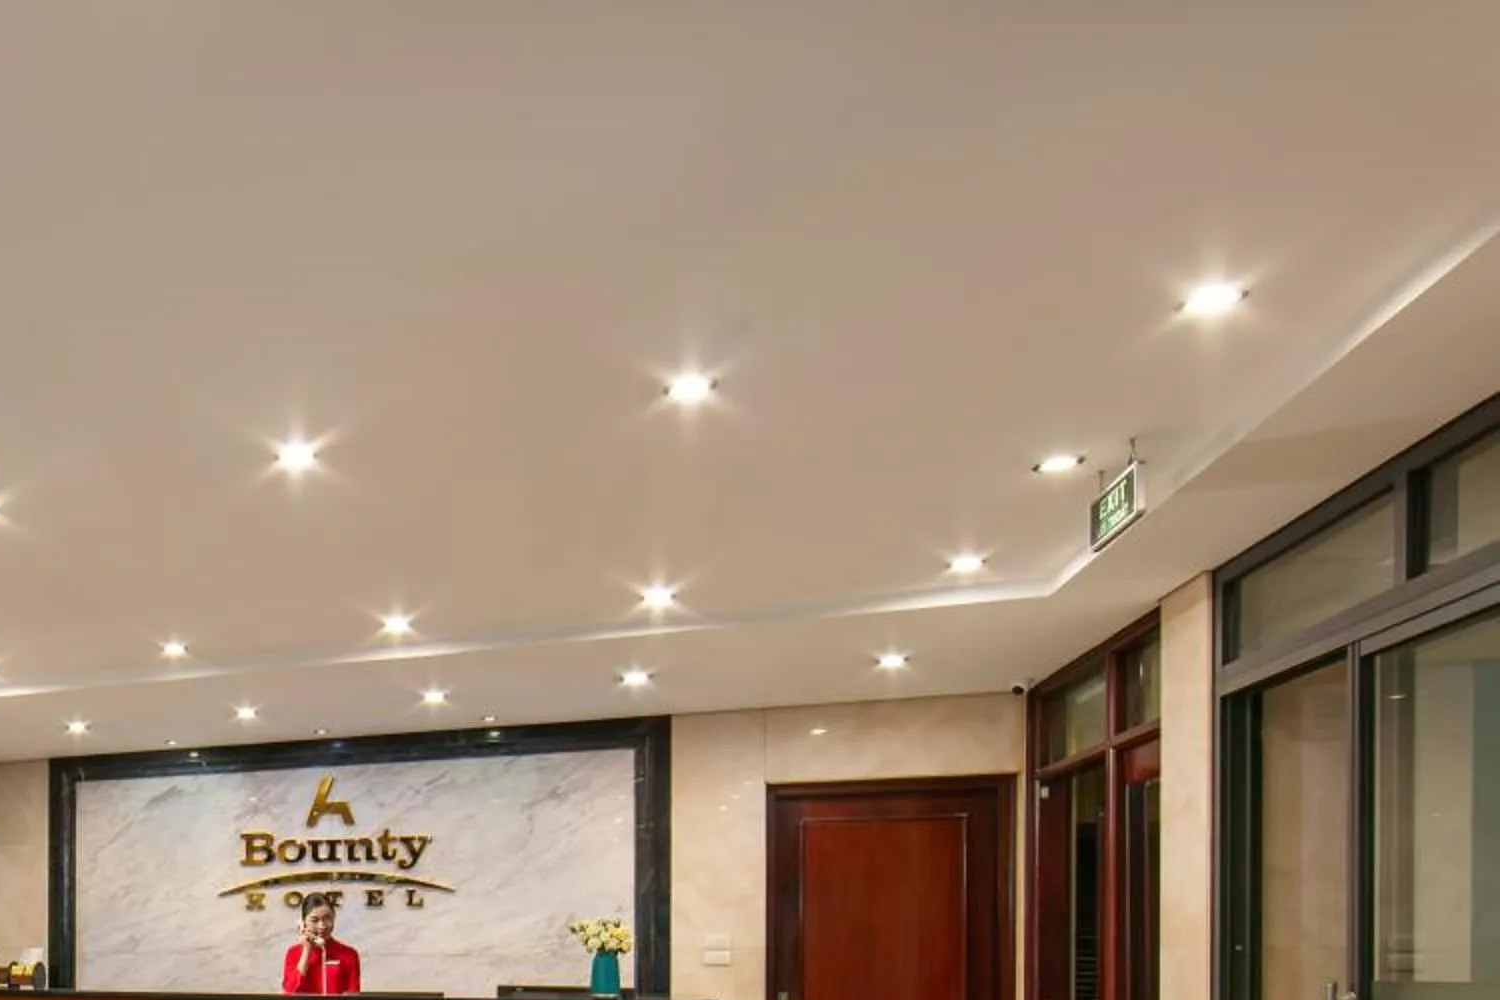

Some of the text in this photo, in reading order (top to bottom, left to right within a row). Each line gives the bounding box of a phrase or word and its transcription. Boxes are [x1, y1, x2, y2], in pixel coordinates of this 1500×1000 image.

[1099, 479, 1127, 520] EXIT
[239, 829, 433, 870] Bounty
[245, 889, 424, 911] HOTEL
